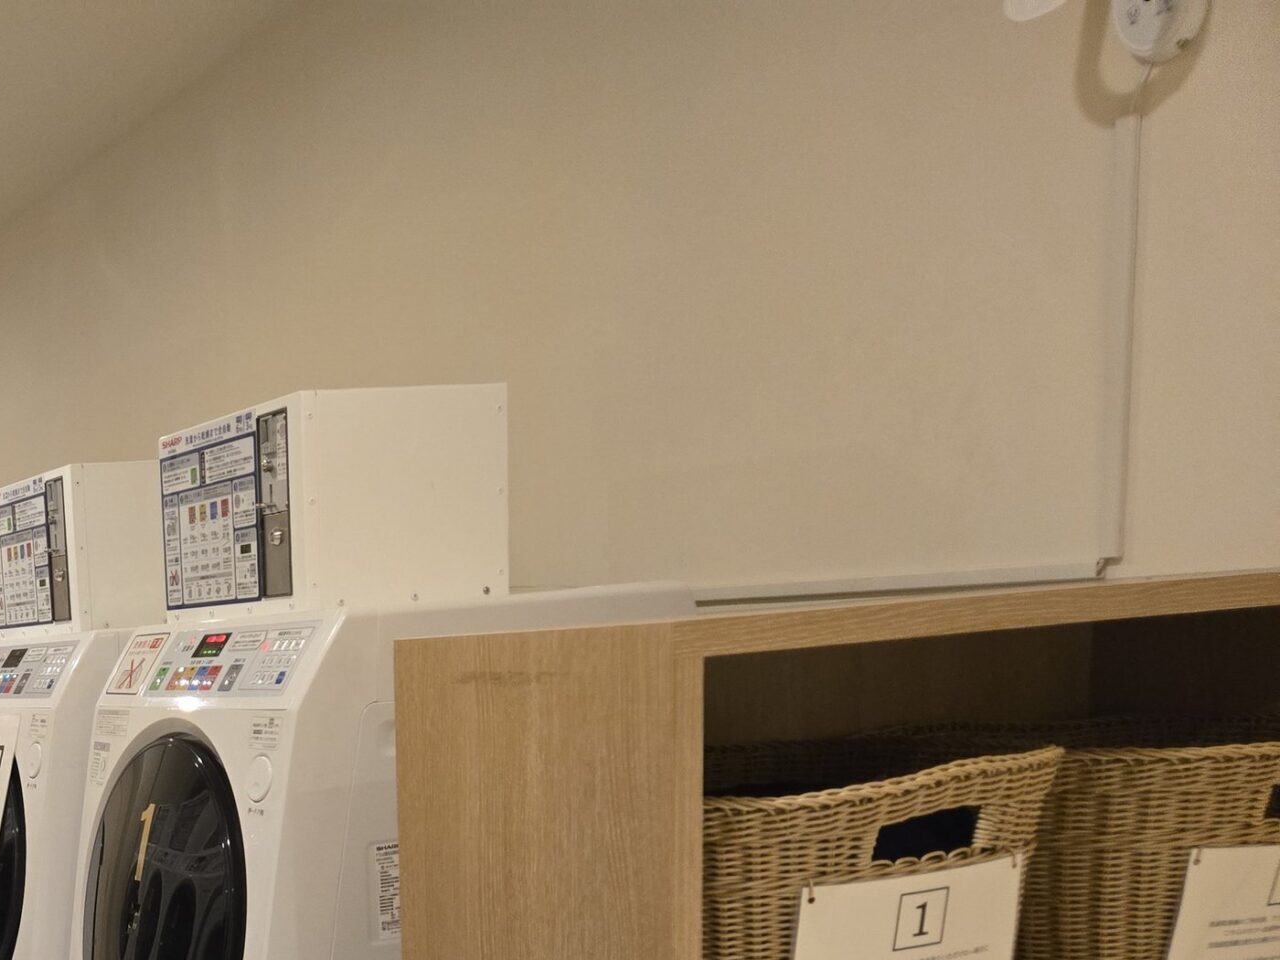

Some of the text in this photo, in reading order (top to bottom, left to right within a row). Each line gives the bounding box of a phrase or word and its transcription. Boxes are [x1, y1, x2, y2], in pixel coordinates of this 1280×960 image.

[161, 436, 182, 450] SHARP
[134, 803, 156, 881] 1
[912, 901, 929, 937] 1
